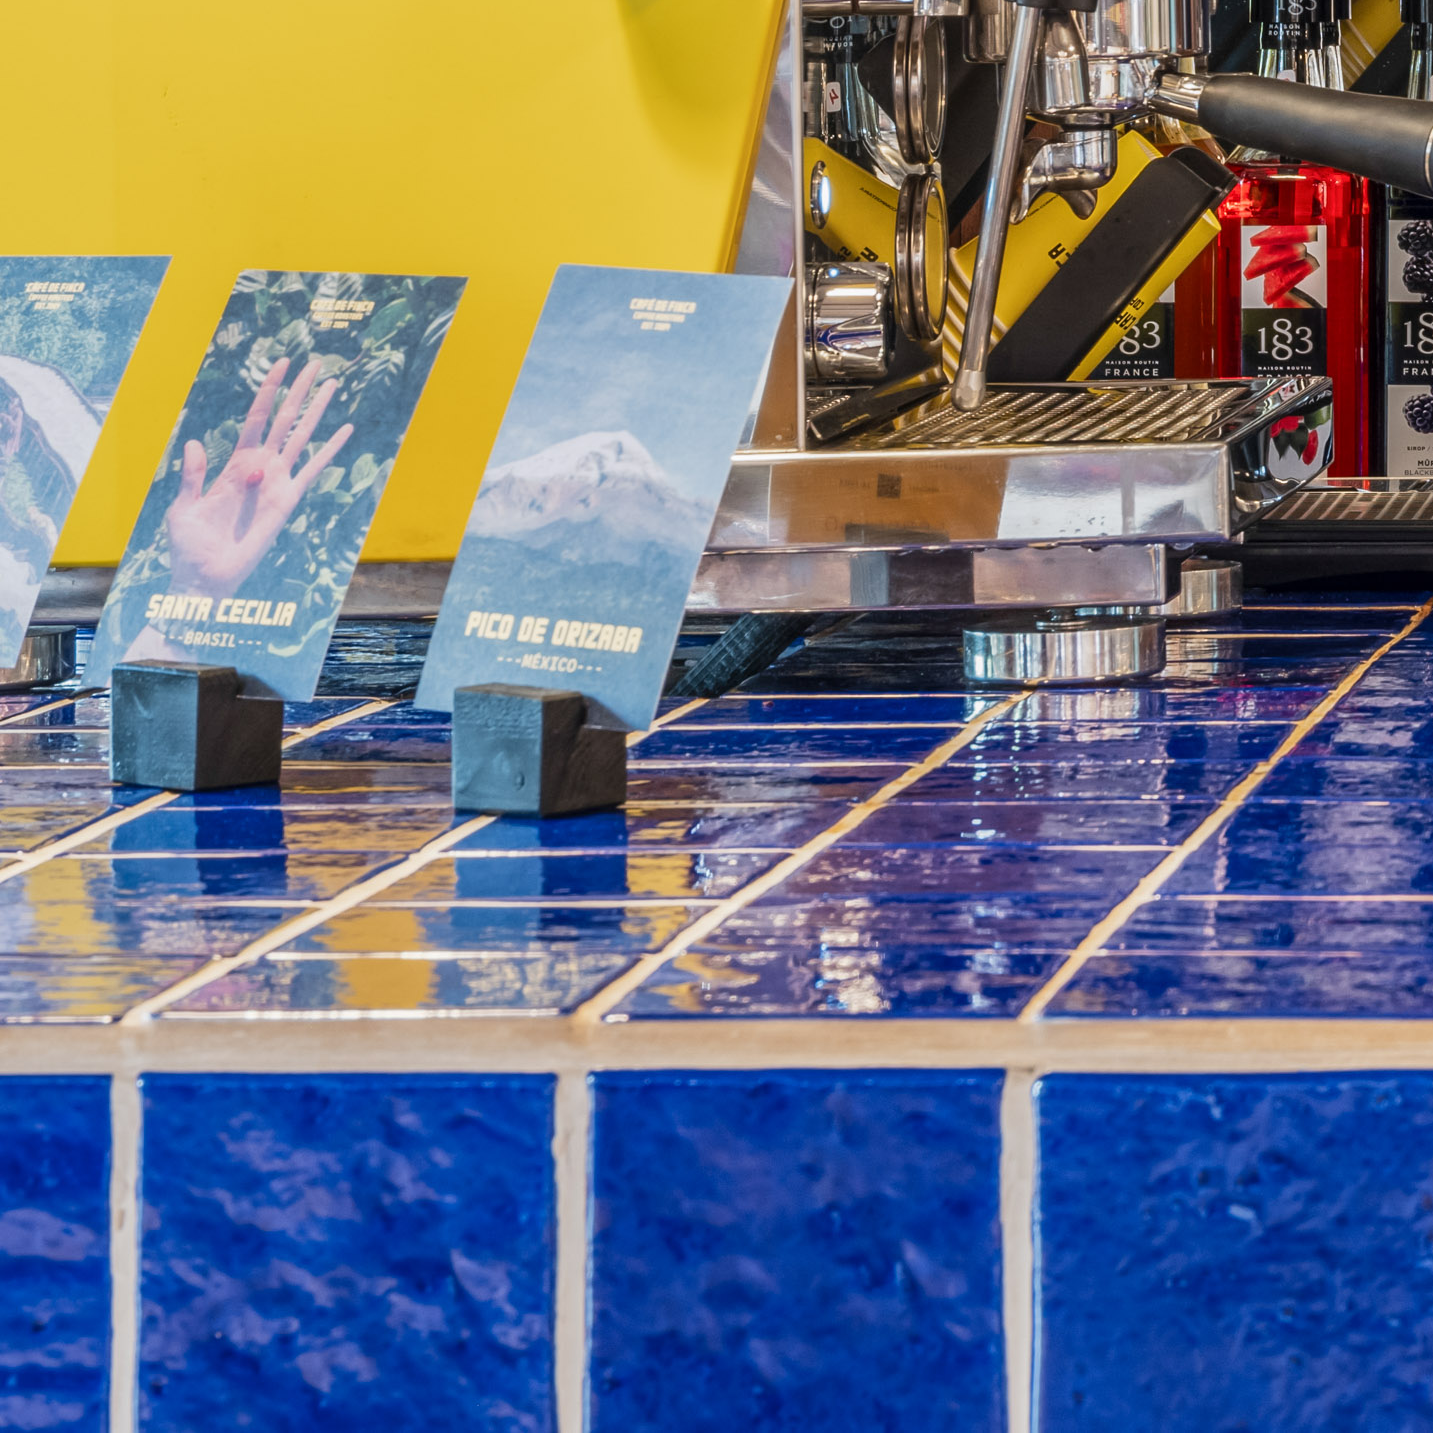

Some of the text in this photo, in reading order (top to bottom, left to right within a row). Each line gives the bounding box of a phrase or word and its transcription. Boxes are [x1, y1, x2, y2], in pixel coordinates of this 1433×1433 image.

[1257, 318, 1314, 361] 183
[1104, 367, 1160, 377] FRANCE
[145, 593, 298, 627] SANTA CECILIA
[464, 610, 644, 654] PICO DE ORIZABA
